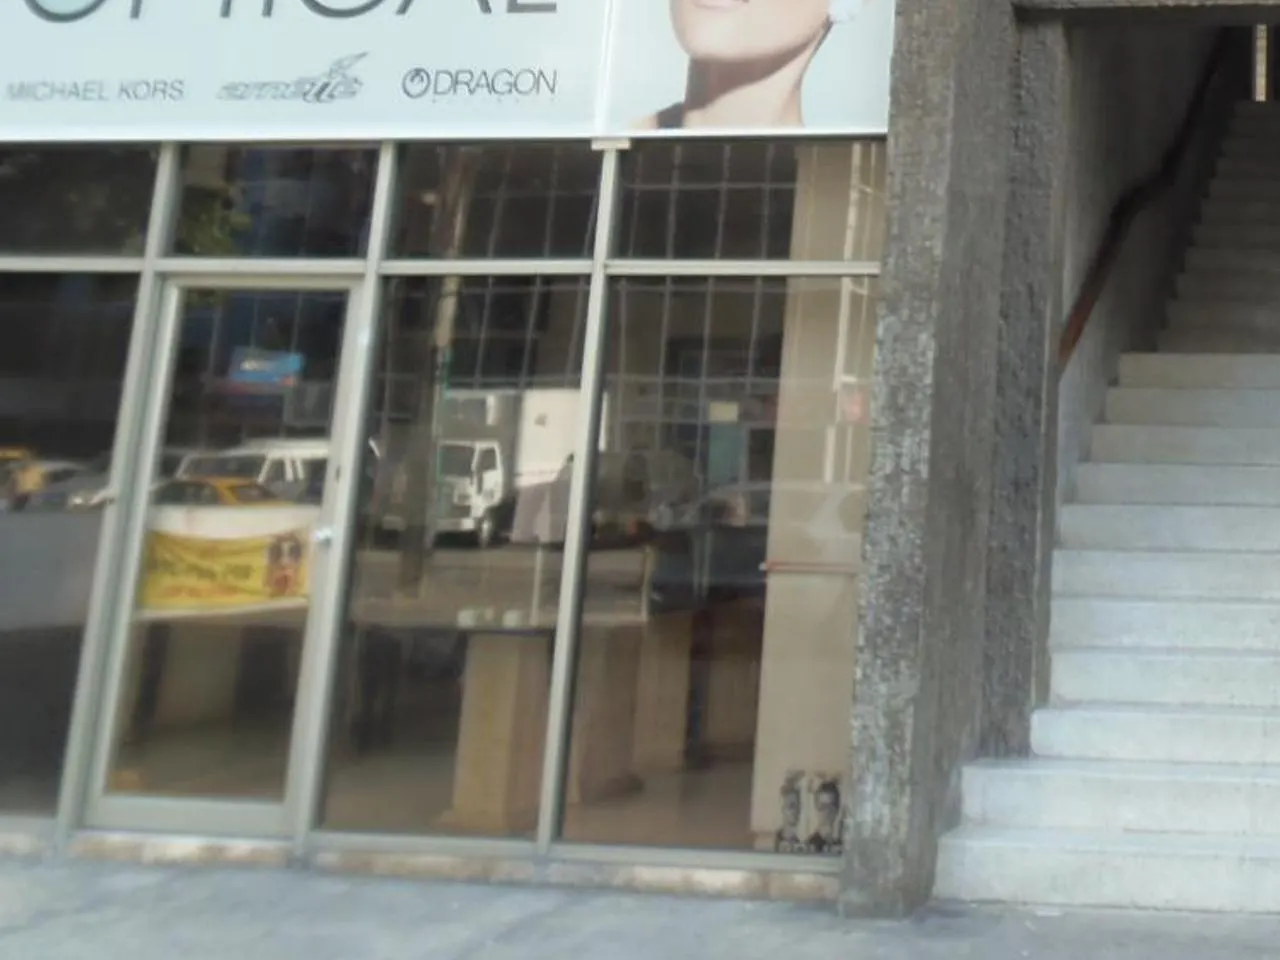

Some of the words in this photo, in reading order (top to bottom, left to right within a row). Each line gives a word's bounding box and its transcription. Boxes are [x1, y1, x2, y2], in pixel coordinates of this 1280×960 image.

[6, 80, 110, 102] MICHAEL
[117, 78, 186, 101] KORS
[433, 68, 558, 97] DRAGON
